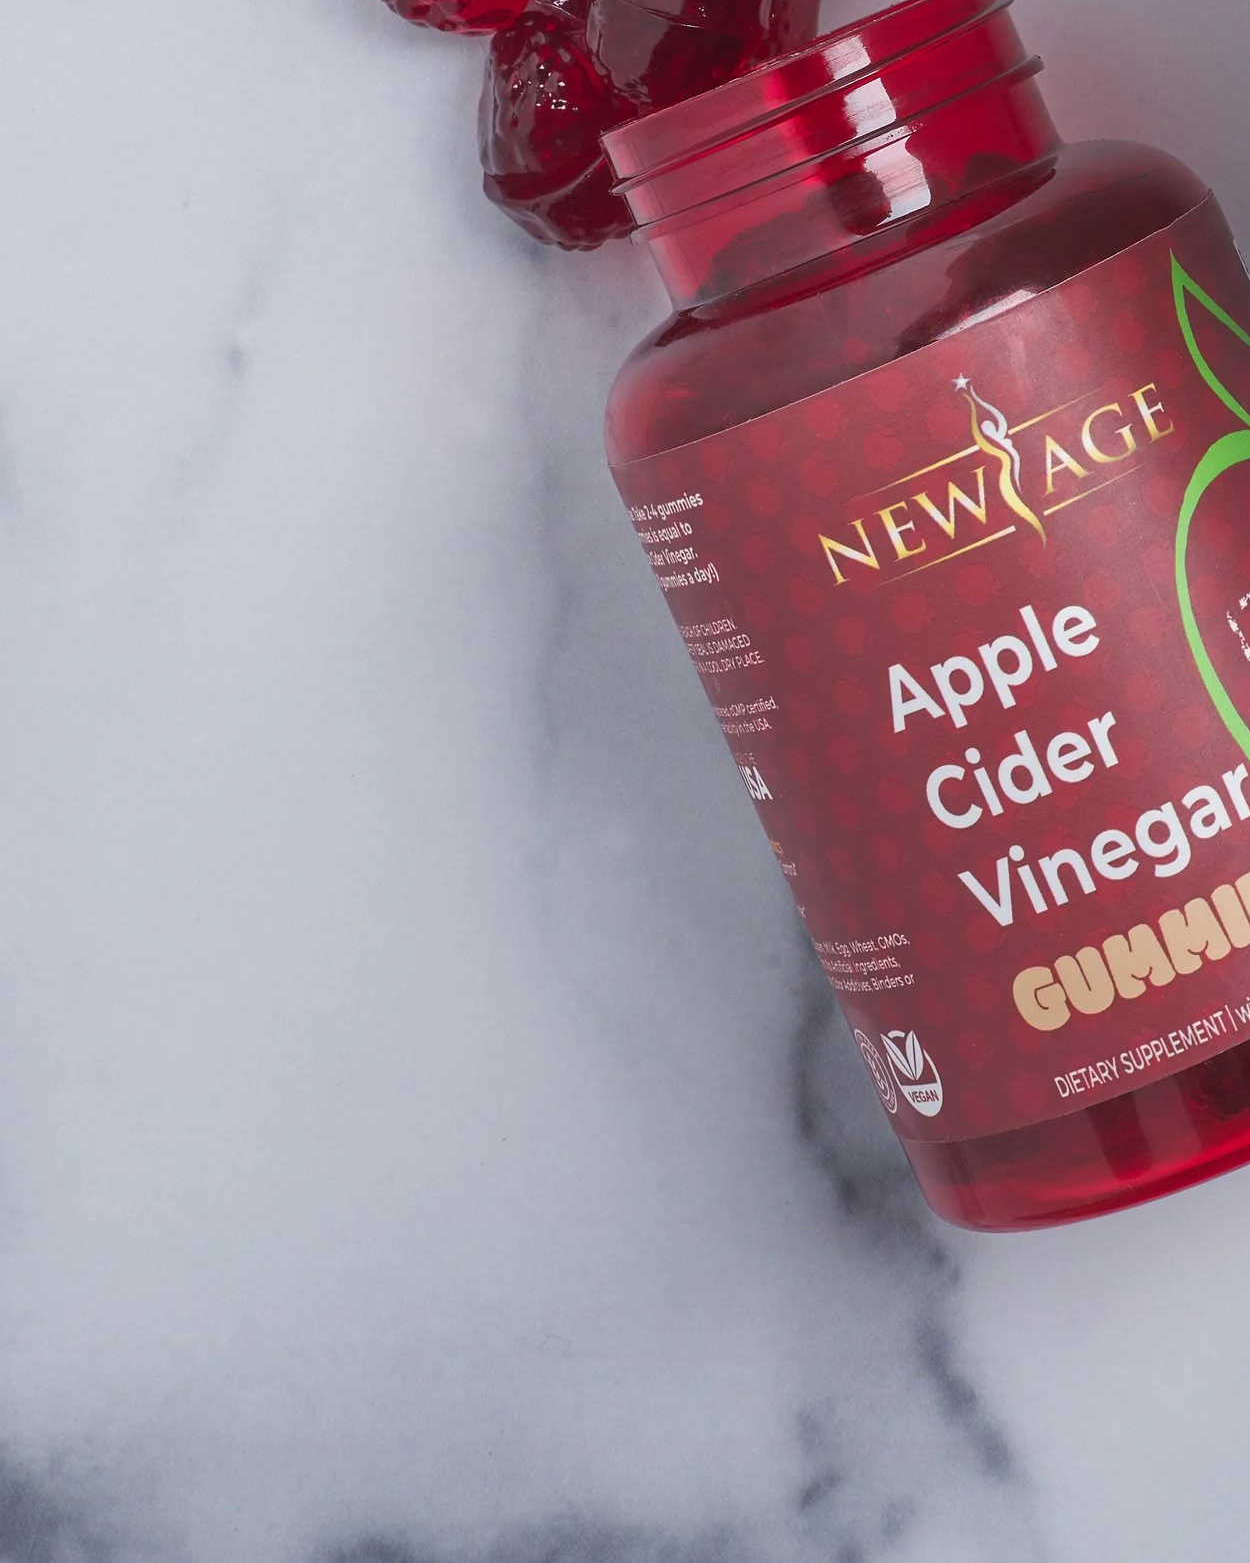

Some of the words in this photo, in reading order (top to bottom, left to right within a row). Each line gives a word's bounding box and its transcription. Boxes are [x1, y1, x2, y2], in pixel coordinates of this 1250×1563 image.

[817, 465, 988, 586] NEW
[1043, 382, 1175, 496] AGE
[657, 492, 704, 520] gummies
[658, 522, 681, 544] equal
[679, 521, 693, 536] to
[713, 633, 751, 654] DAMAGED
[887, 604, 1101, 734] Apple
[738, 764, 775, 800] USA
[925, 710, 1119, 829] Cider
[877, 932, 911, 950] GMOs,
[851, 955, 901, 976] Ingredients,
[870, 974, 905, 991] Binders
[904, 973, 915, 985] or
[1053, 1055, 1119, 1098] DIETARY
[1119, 1009, 1229, 1075] SUPPLEMENT
[907, 1089, 940, 1104] VEGAN
